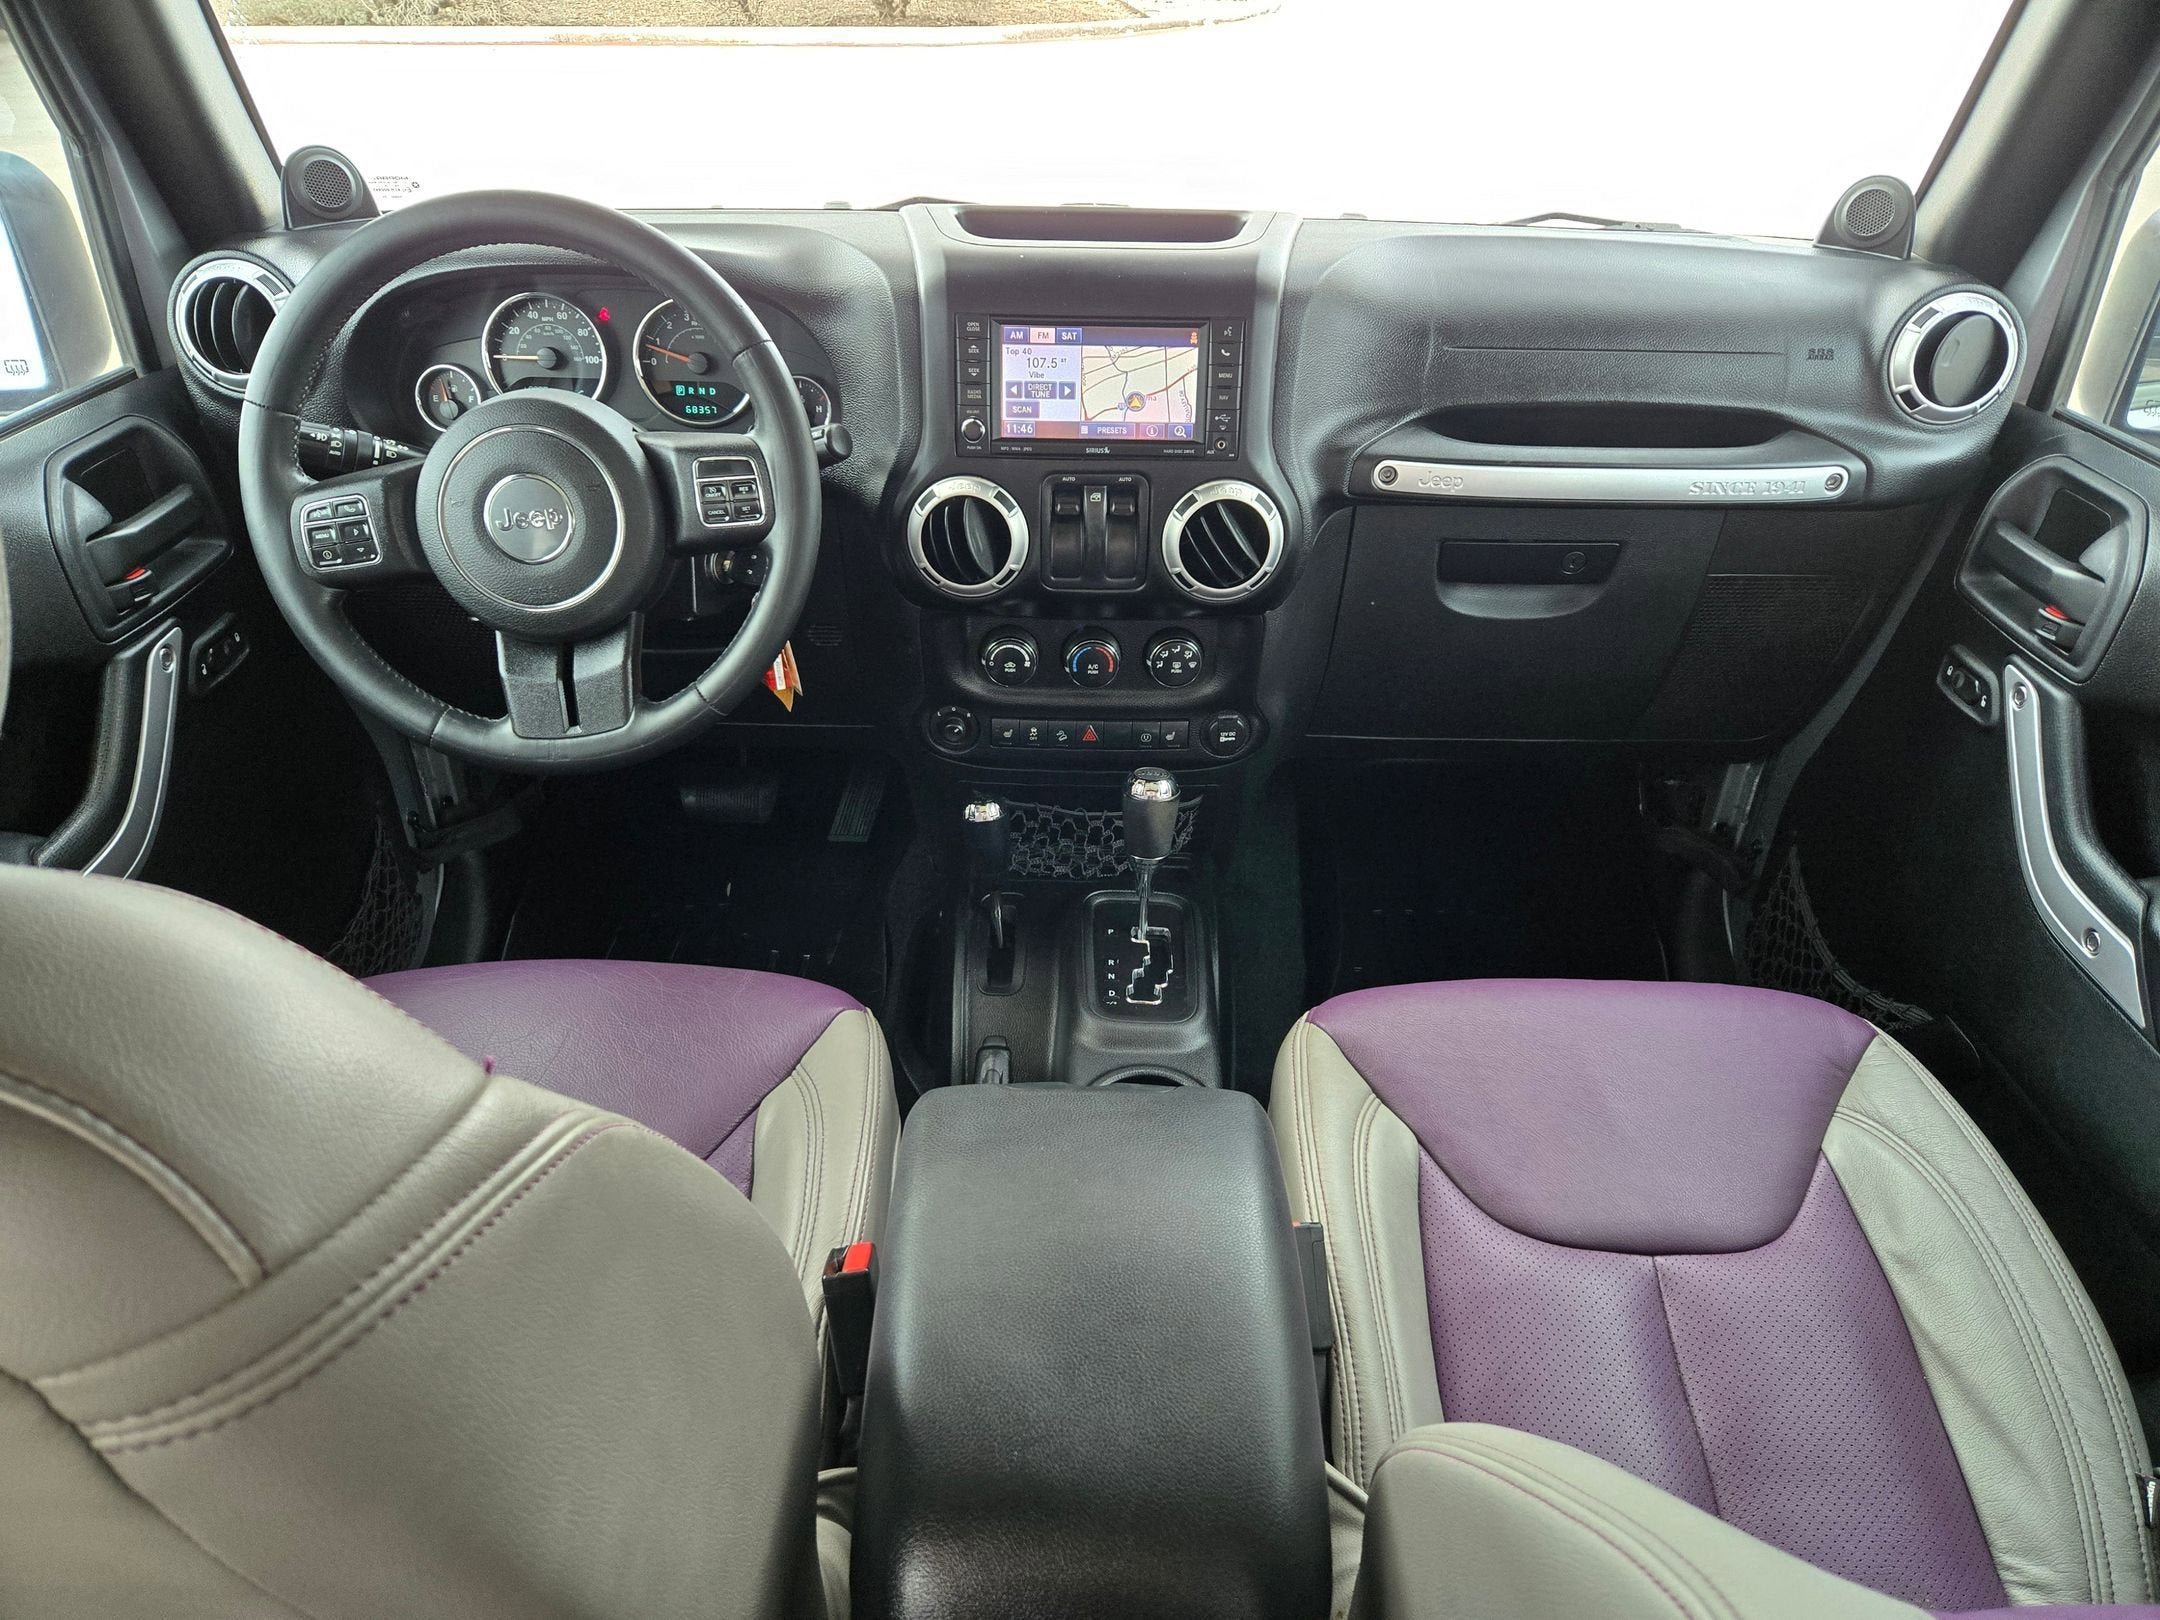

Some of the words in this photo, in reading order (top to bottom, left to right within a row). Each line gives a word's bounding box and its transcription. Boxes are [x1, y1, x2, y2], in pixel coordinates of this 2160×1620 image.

[528, 311, 539, 319] 40
[557, 312, 568, 320] 60
[684, 313, 690, 321] 3
[508, 327, 520, 335] 20
[577, 328, 589, 337] 80
[1010, 331, 1024, 339] AM
[1061, 332, 1077, 341] SAT
[1006, 346, 1020, 357] Top
[1022, 347, 1032, 355] 40
[584, 355, 600, 364] 100
[651, 358, 657, 366] 0
[1027, 357, 1058, 369] 107.5
[1028, 371, 1045, 379] Vibe
[1028, 383, 1053, 391] DIRECT
[433, 394, 439, 402] E
[468, 395, 475, 403] F
[685, 405, 718, 415] 68357
[815, 405, 823, 413] H
[1012, 405, 1032, 414] SCAN
[1006, 423, 1034, 434] 11:46
[1097, 426, 1128, 435] PRESETS
[1418, 470, 1464, 493] Jeep
[1688, 480, 1758, 496] SINCE
[495, 507, 563, 532] Jeep
